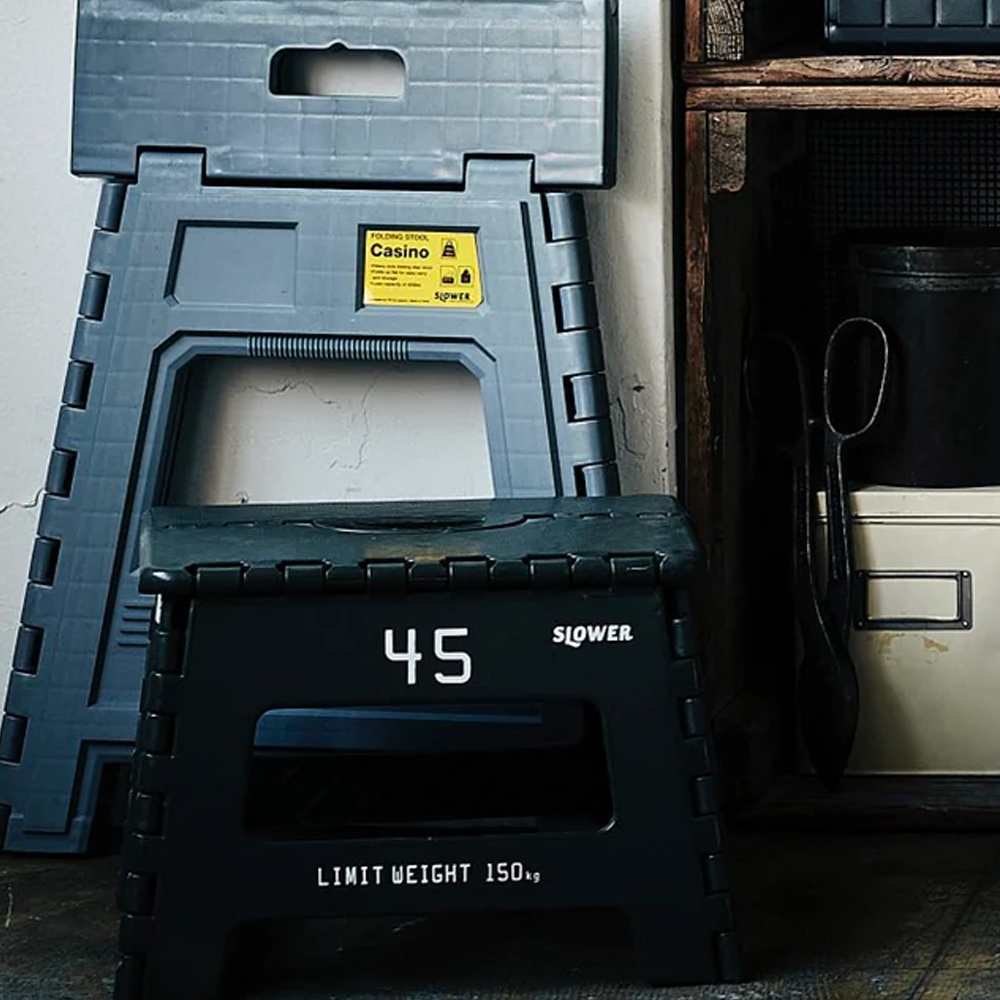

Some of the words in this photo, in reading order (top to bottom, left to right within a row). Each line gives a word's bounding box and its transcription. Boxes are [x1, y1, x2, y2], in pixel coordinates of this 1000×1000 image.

[371, 233, 403, 241] FOLDING
[405, 233, 430, 242] STOOL
[370, 243, 430, 258] Casino
[434, 292, 470, 302] SLOWER
[552, 624, 634, 648] SLOWER
[384, 627, 473, 685] 45
[317, 866, 384, 887] LIMIT
[391, 863, 472, 885] WEIGHT
